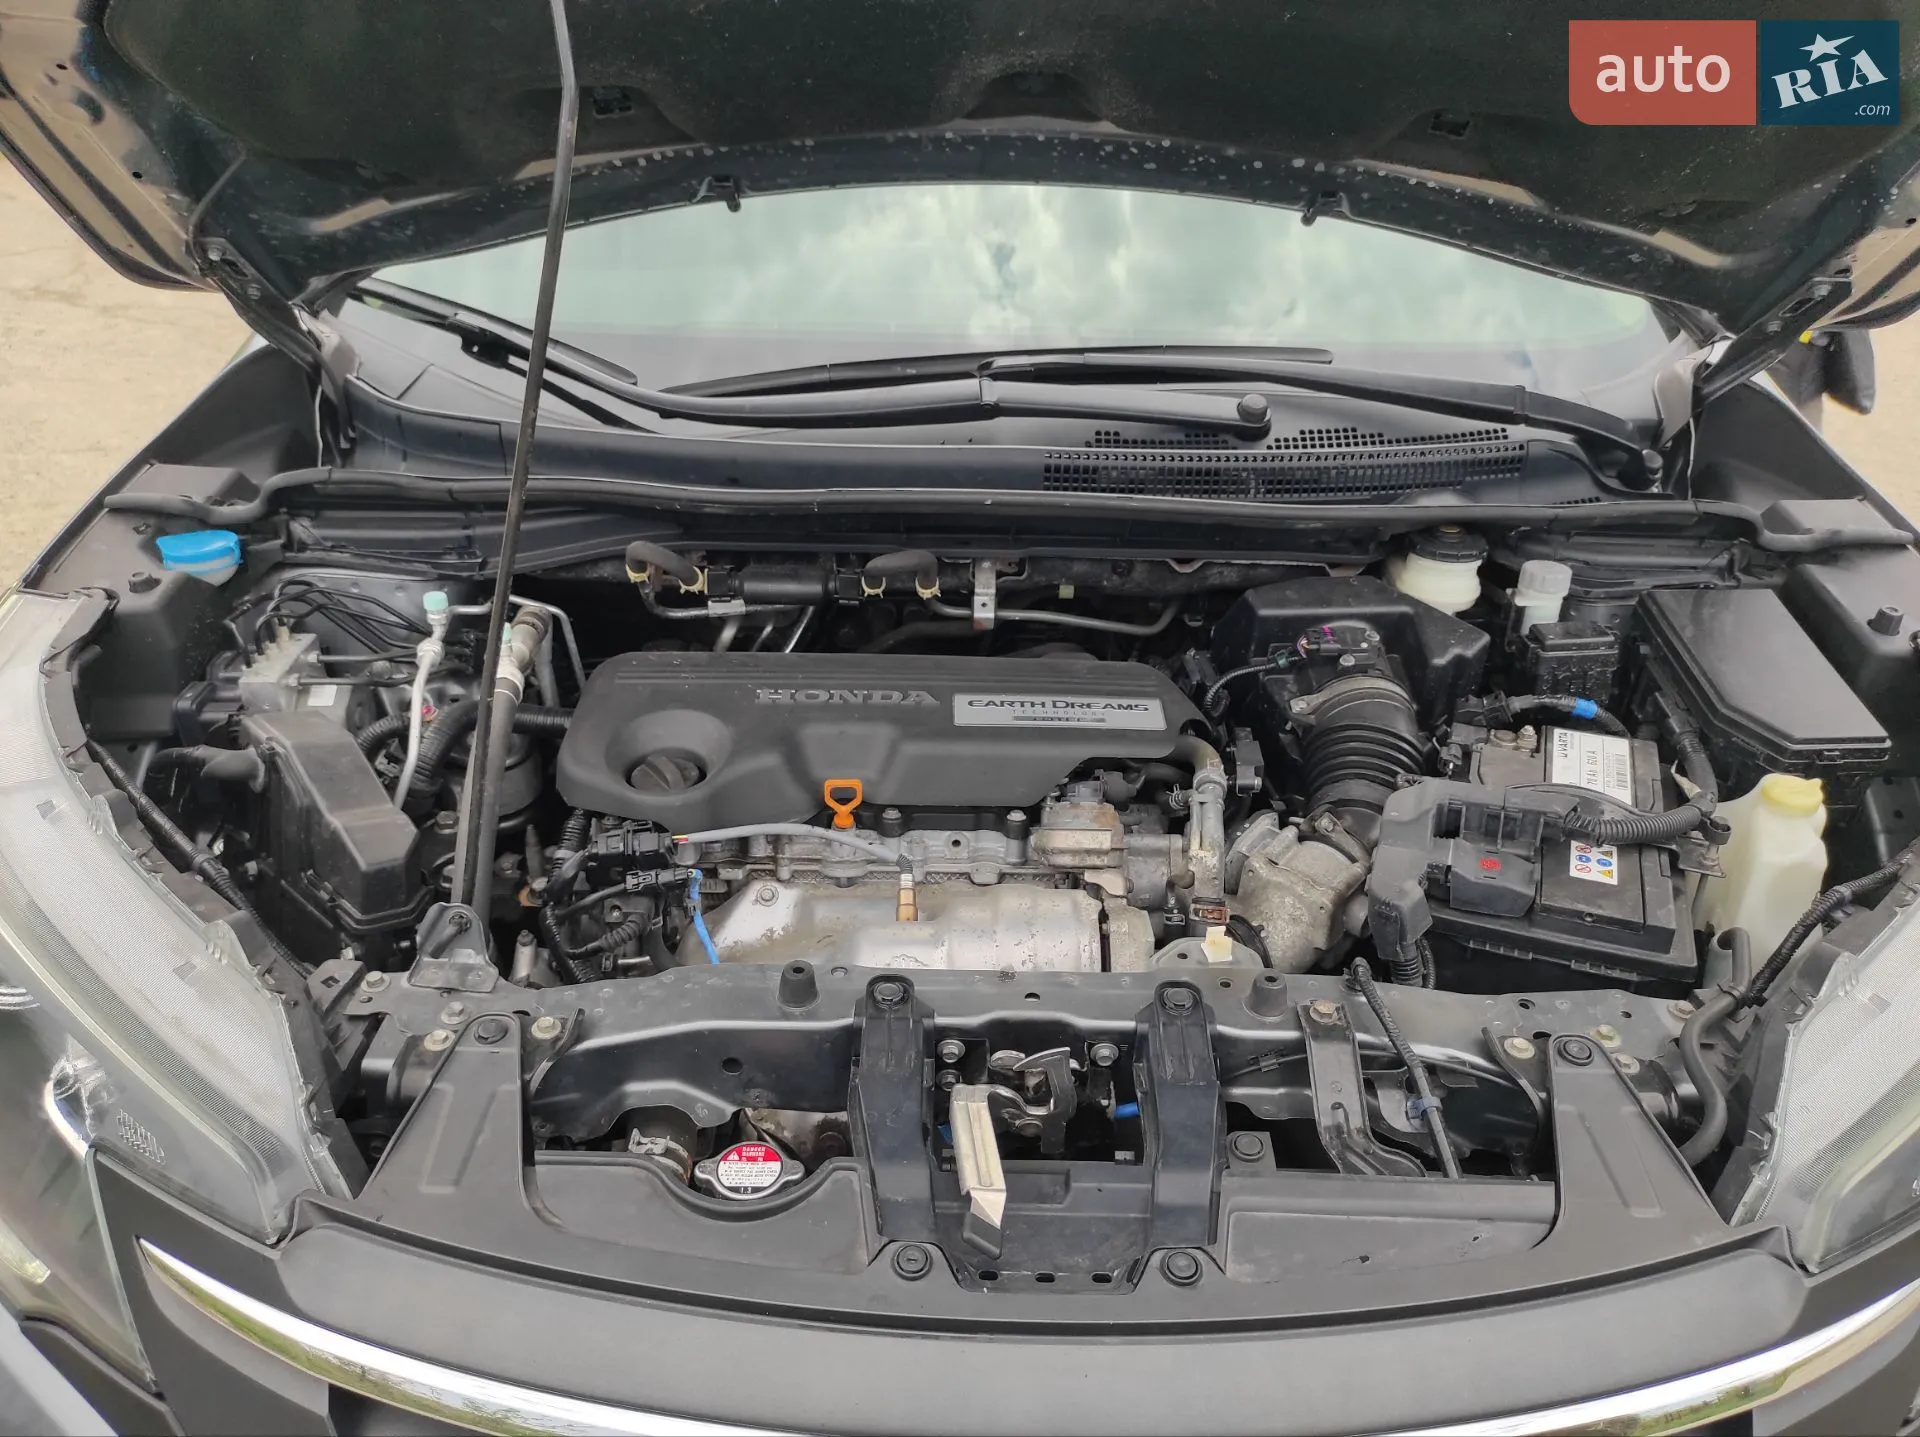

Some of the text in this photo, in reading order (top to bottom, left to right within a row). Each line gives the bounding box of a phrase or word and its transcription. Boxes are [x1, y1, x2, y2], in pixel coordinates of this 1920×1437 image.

[754, 689, 941, 705] HONDA
[967, 700, 1150, 712] EARTH DREAMS
[1557, 732, 1569, 752] VARTA
